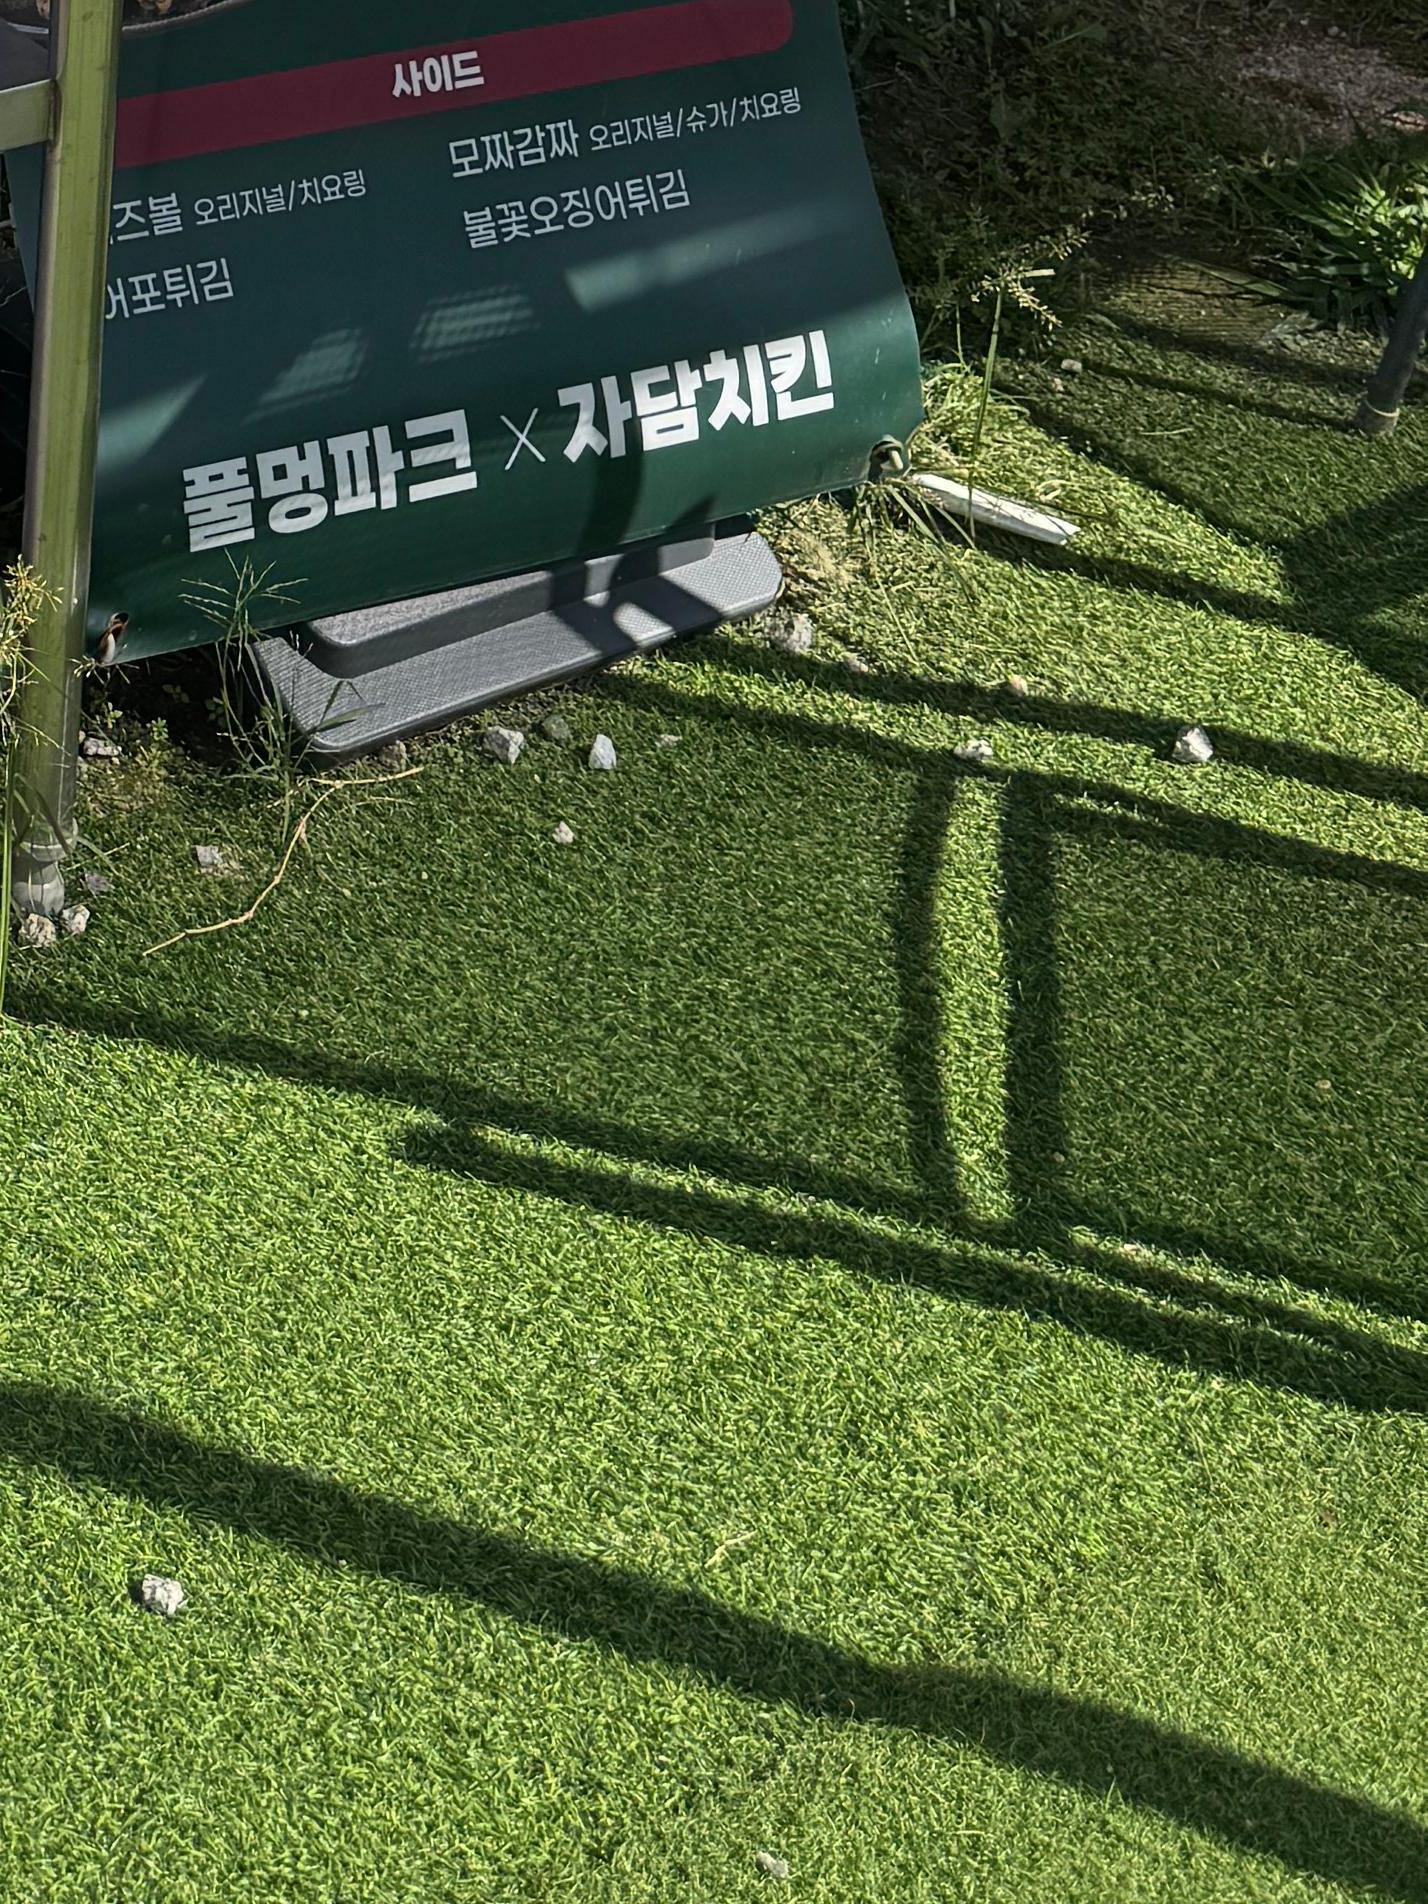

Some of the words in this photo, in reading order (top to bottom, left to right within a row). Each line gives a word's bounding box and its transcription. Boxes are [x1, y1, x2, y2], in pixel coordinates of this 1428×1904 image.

[391, 49, 485, 99] 사이드
[449, 119, 580, 178] 모짜감짜
[589, 87, 802, 152] 오리지널/슈가/치요링
[109, 192, 183, 244] 즈볼
[194, 169, 366, 226] 오리지널/치요링
[463, 169, 690, 249] 불꽃오징어튀김
[181, 407, 478, 554] 풀멍파크
[557, 329, 836, 464] 자담치킨
